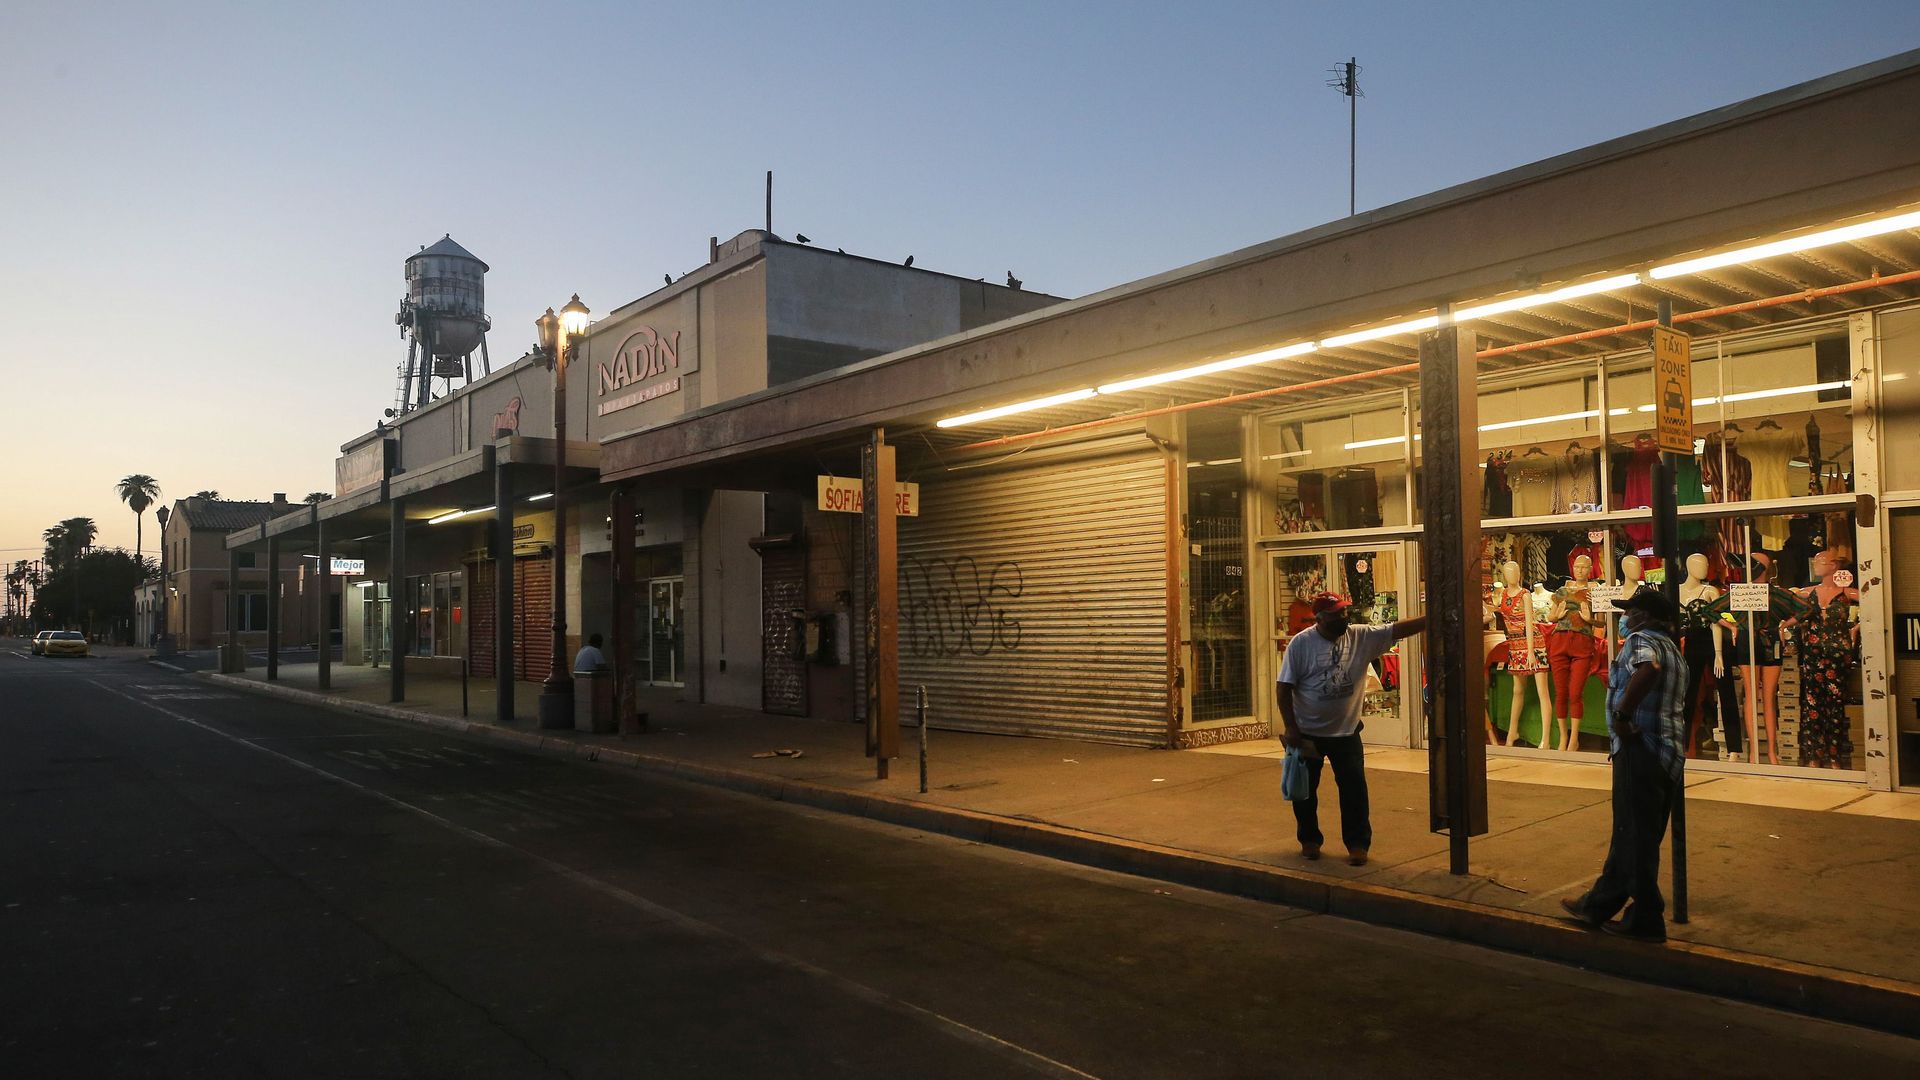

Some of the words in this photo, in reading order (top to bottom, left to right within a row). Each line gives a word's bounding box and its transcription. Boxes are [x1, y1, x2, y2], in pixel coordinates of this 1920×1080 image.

[597, 327, 680, 397] NADIN
[1660, 358, 1686, 377] ZONE
[826, 488, 863, 511] SOFIA
[333, 560, 364, 570] Mejor
